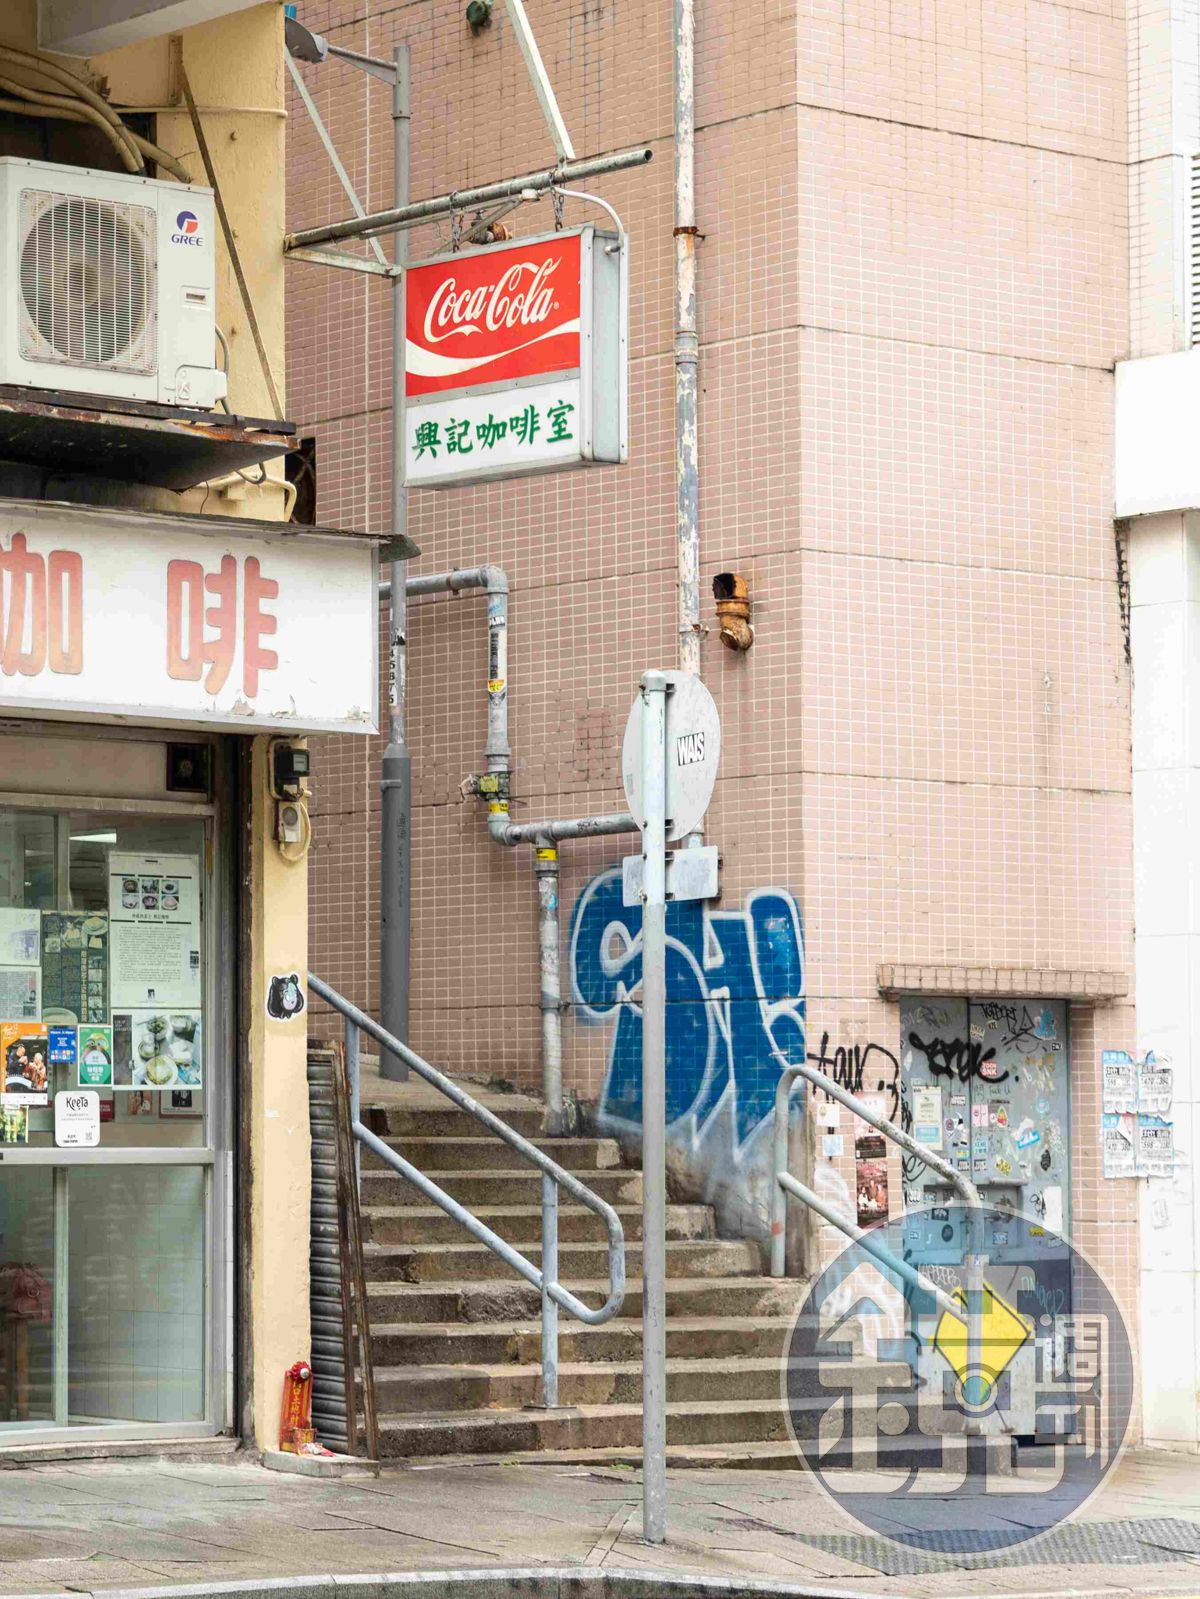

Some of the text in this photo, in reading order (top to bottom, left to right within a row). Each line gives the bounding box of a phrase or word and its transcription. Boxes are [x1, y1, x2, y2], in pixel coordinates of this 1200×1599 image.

[171, 233, 204, 247] GREE
[424, 256, 563, 343] Coca-Cola
[411, 400, 575, 462] 興記咖啡室
[677, 732, 704, 766] WAIS
